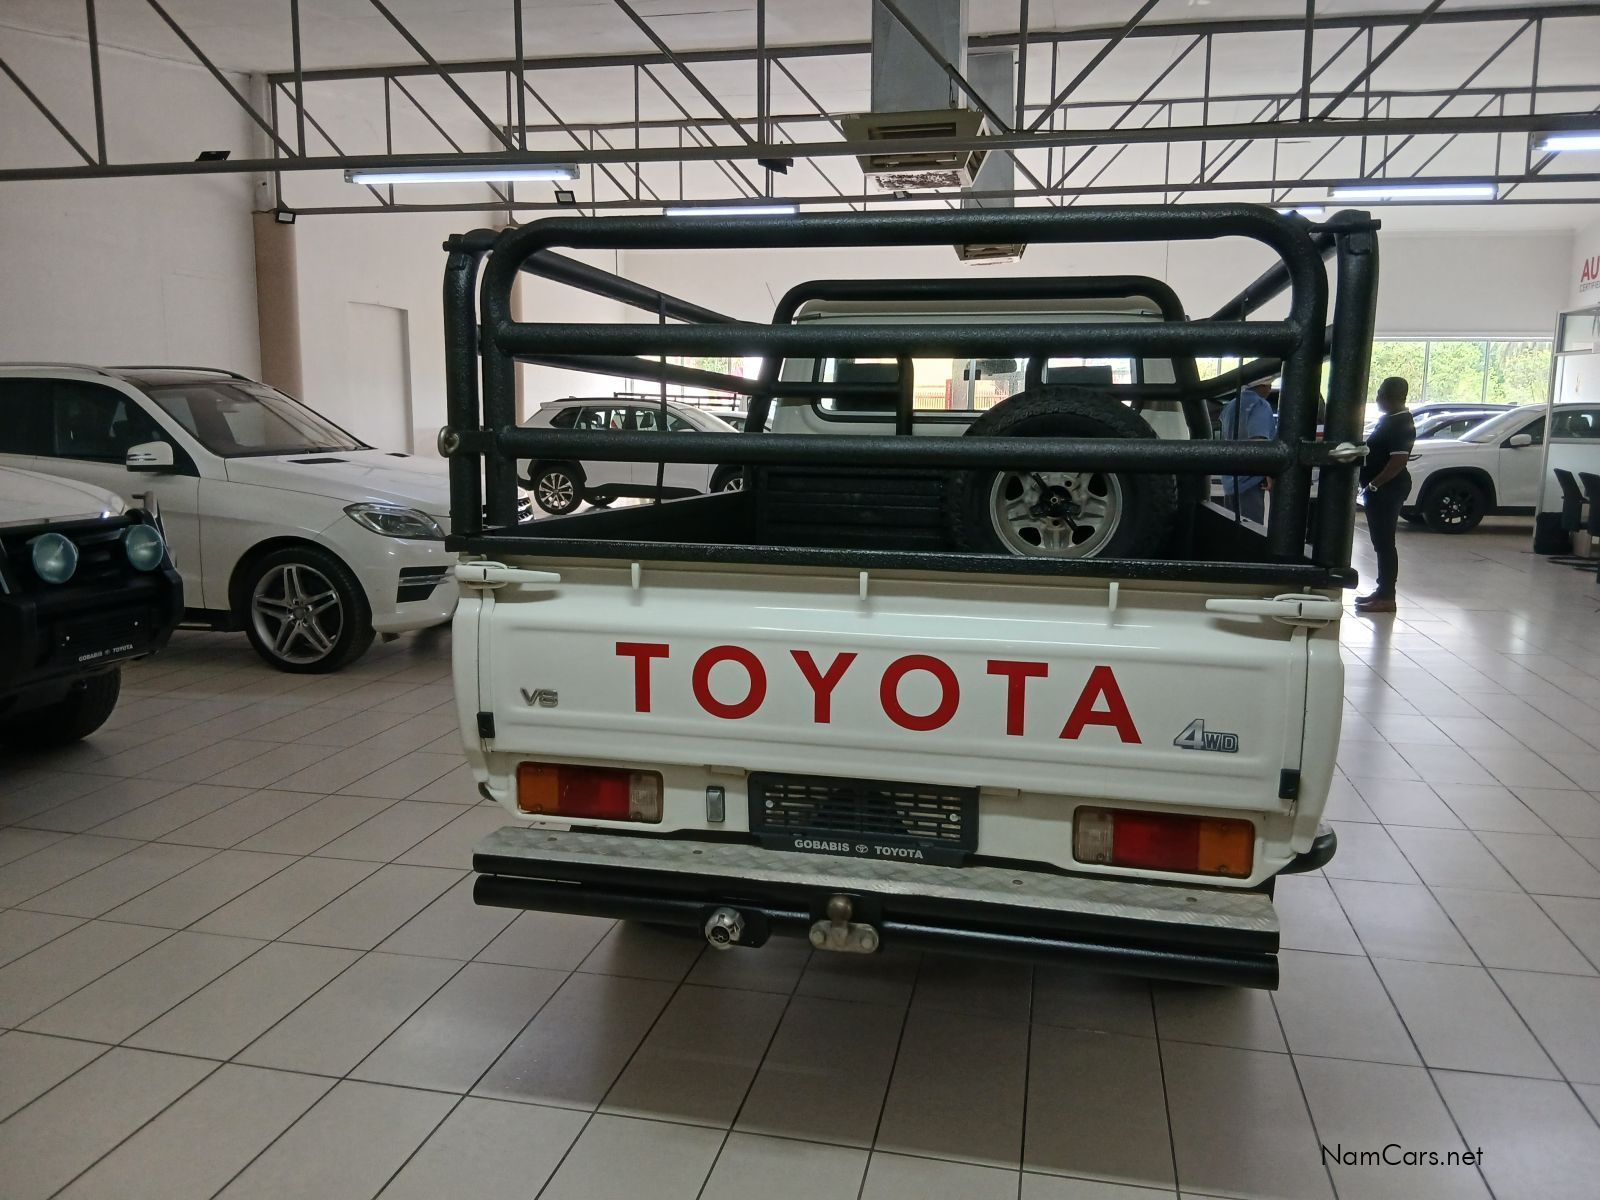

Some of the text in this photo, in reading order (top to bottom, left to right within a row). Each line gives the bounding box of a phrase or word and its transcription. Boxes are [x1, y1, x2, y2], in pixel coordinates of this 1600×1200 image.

[615, 641, 1143, 744] TOYOTA
[1173, 718, 1239, 753] 4WD
[794, 839, 924, 859] GOBABIS TOYOTA
